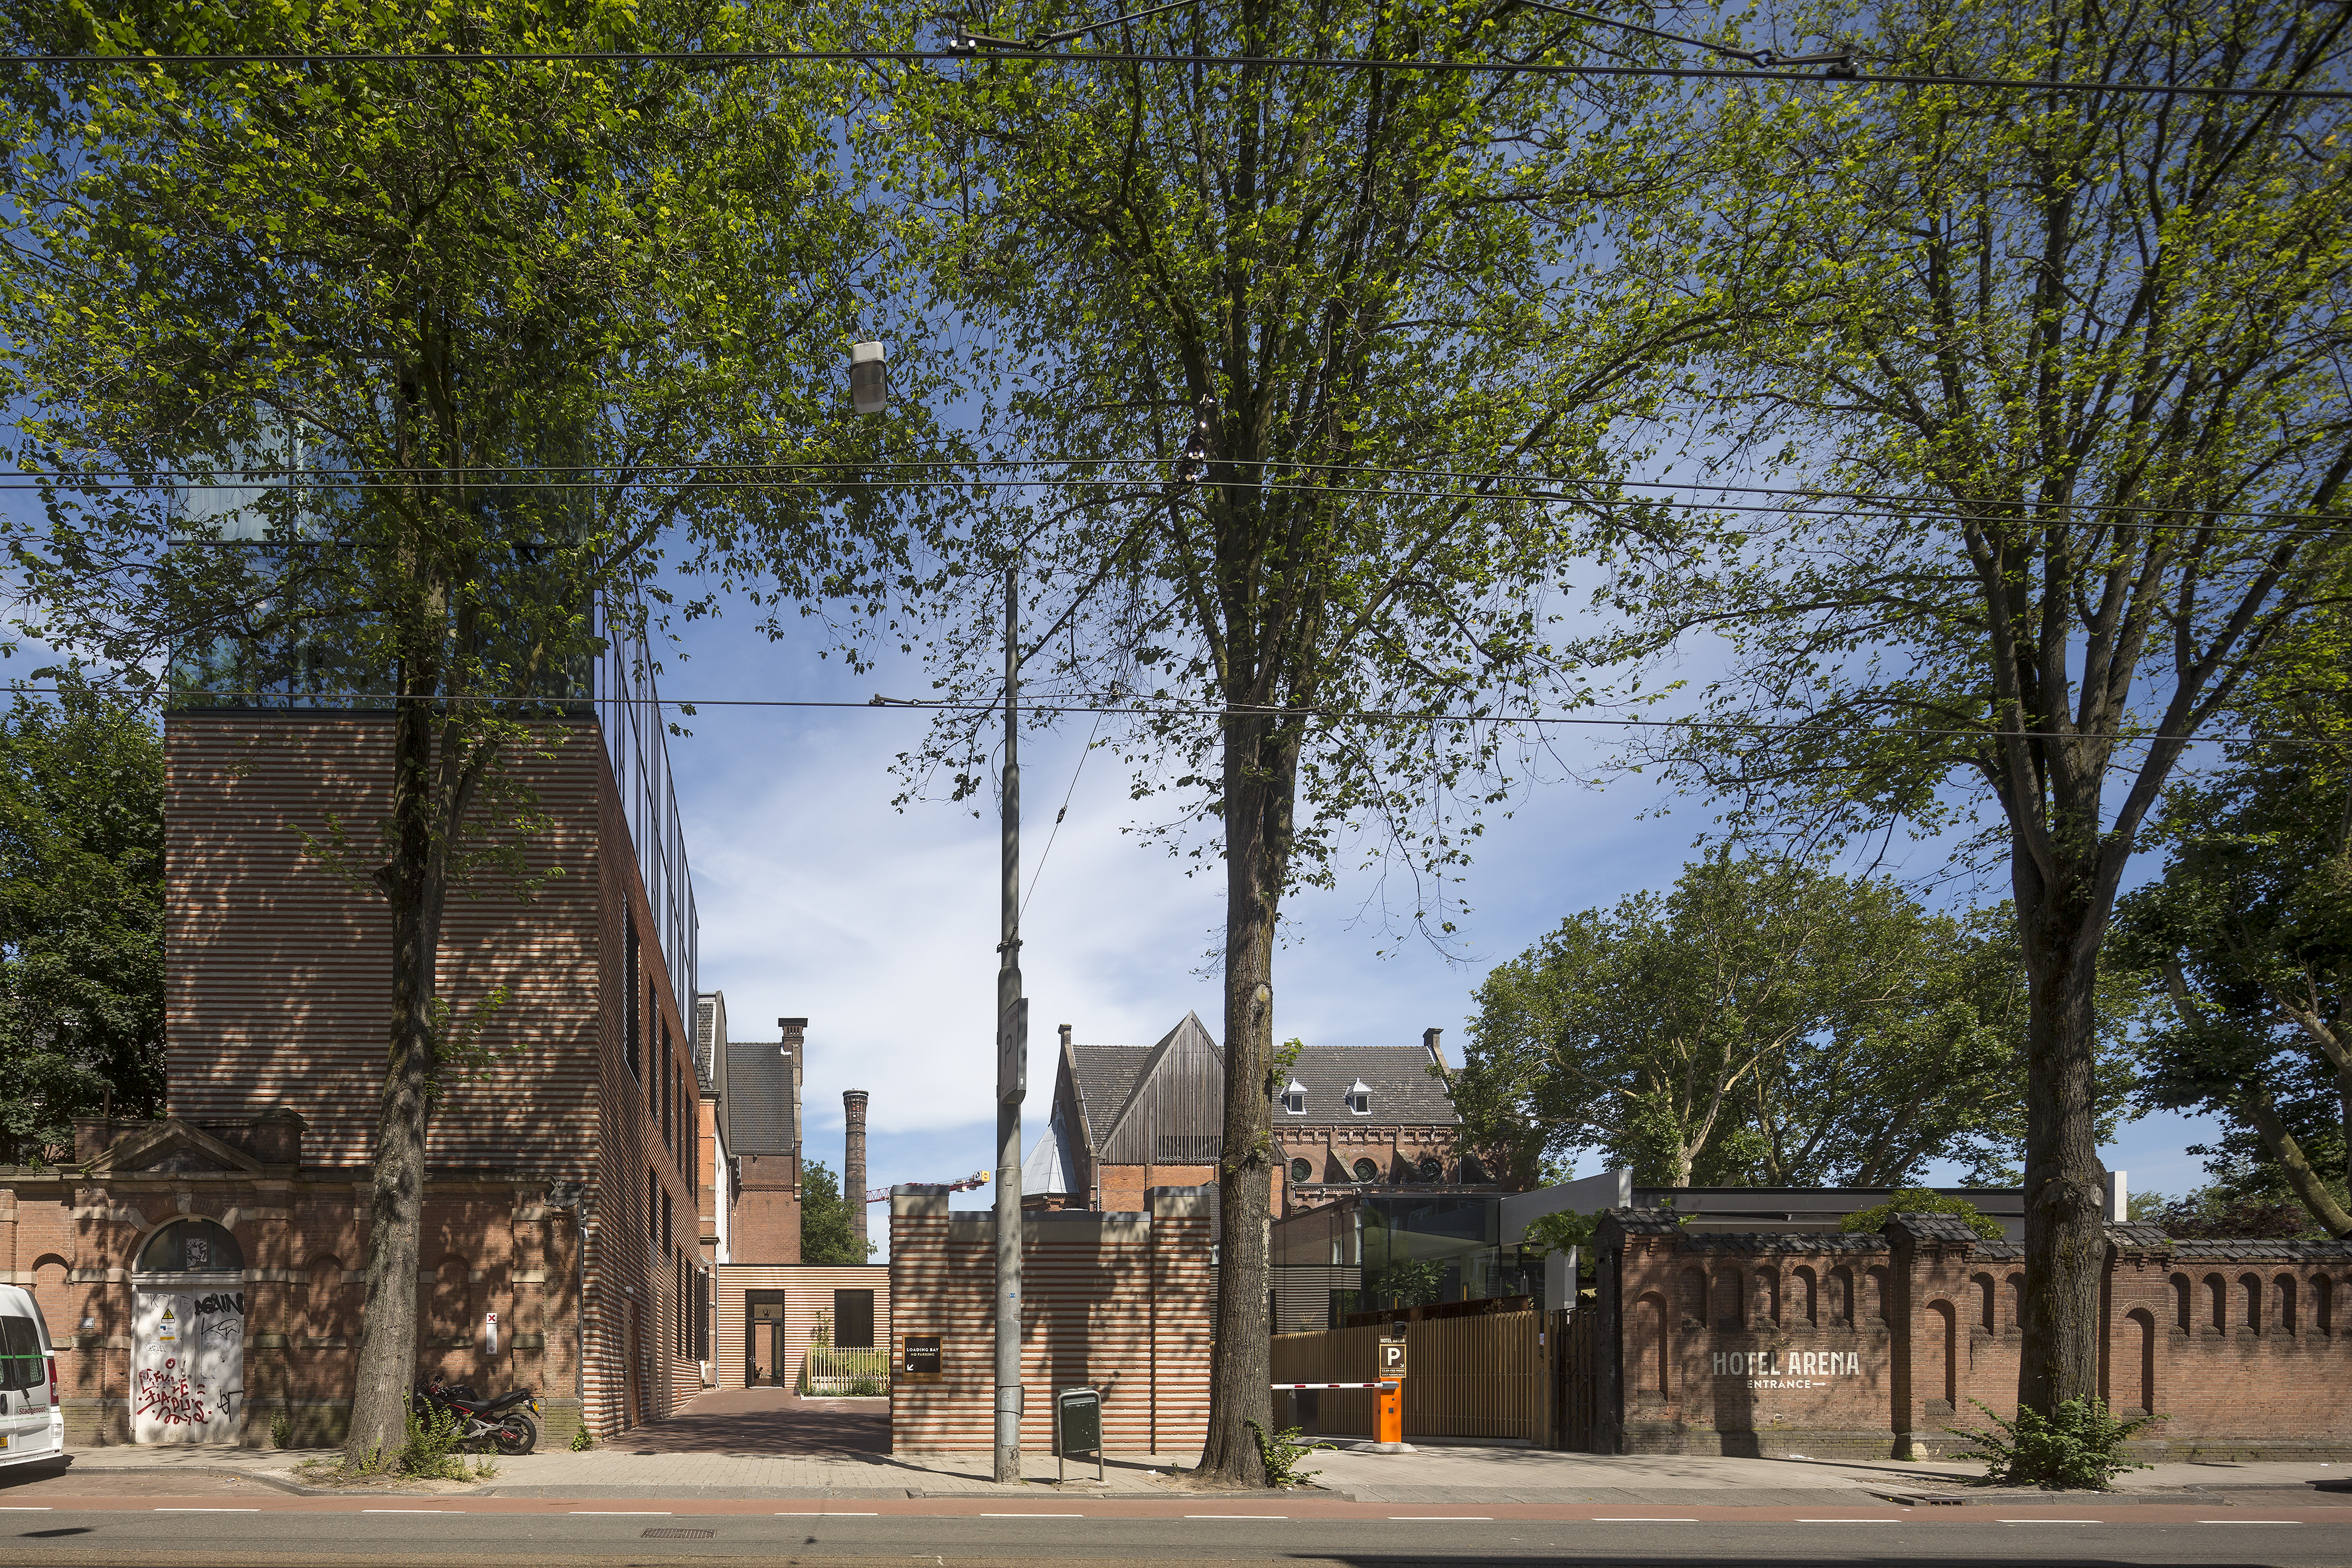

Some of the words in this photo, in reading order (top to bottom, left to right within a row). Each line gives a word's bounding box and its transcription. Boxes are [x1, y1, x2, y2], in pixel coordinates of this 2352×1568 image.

[1005, 1033, 1012, 1069] P
[1387, 1348, 1401, 1366] P
[1713, 1352, 1780, 1375] HOTEL
[1788, 1352, 1859, 1375] ARENA
[1747, 1379, 1811, 1389] ENTRANCE
[19, 1406, 46, 1415] Stadgenoot
